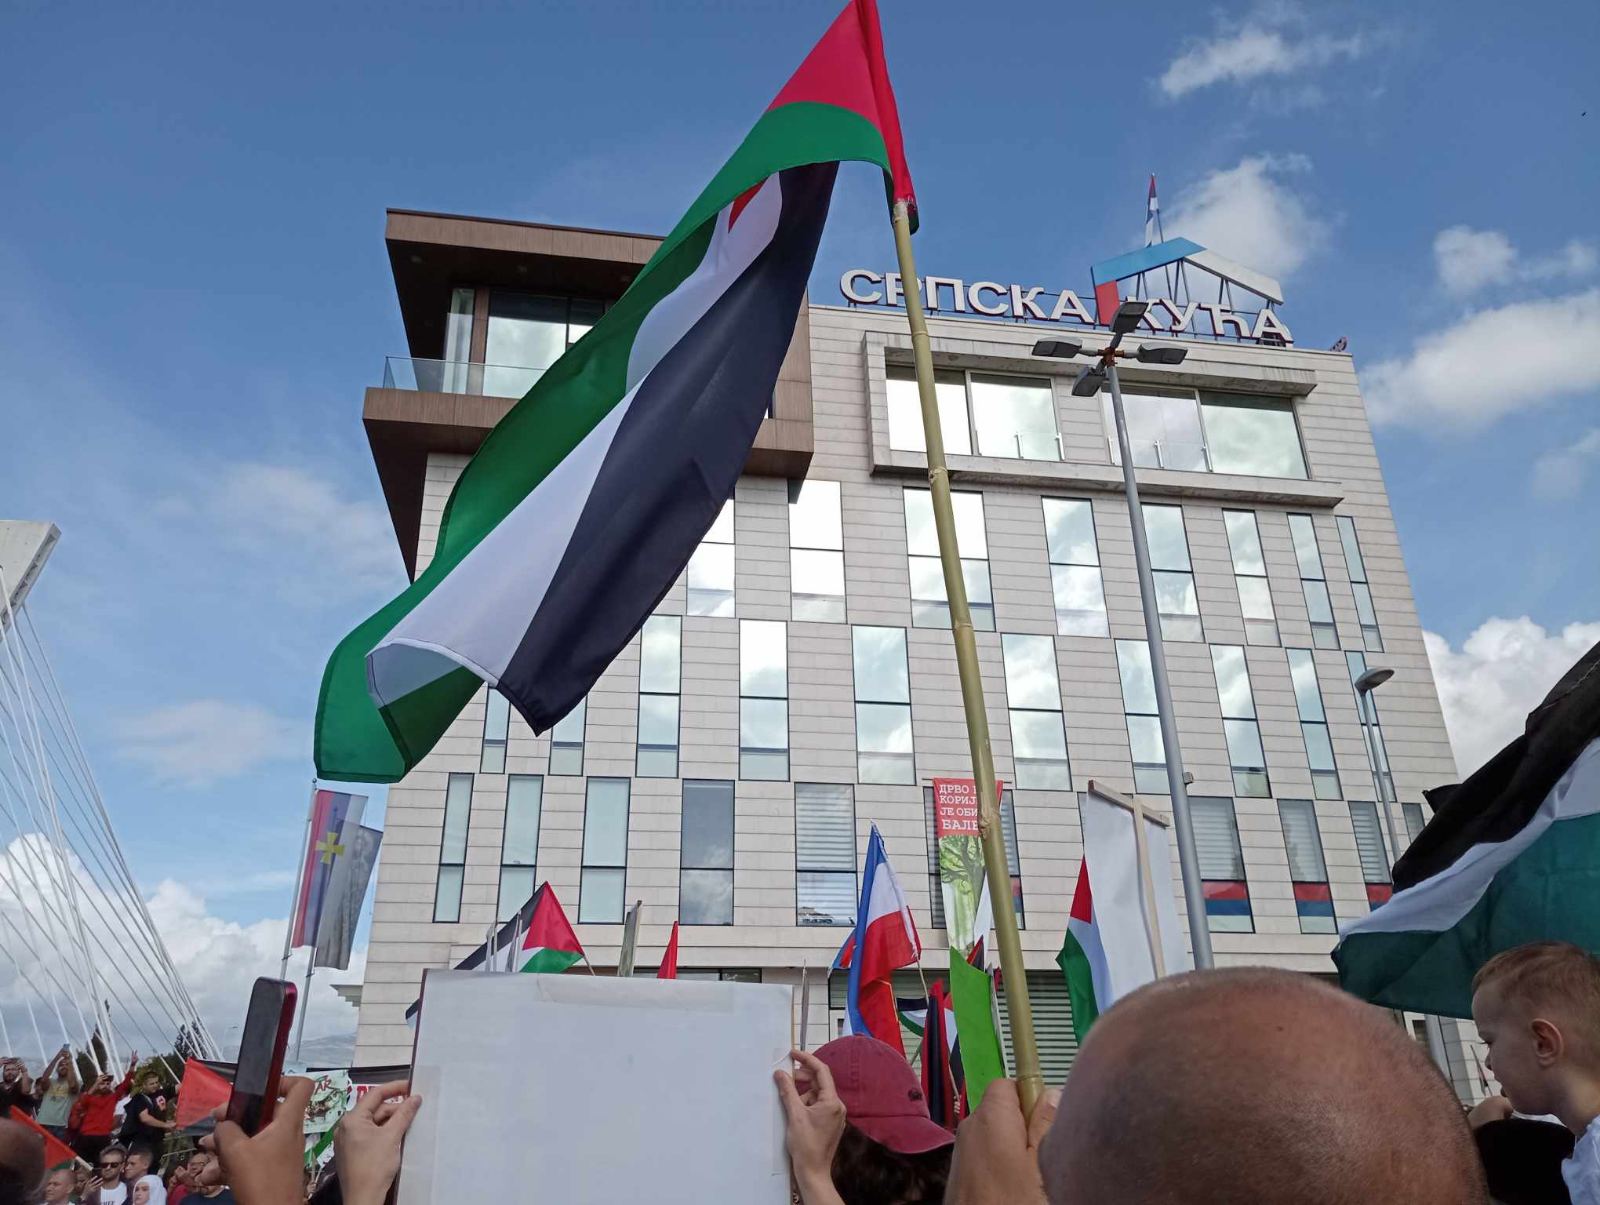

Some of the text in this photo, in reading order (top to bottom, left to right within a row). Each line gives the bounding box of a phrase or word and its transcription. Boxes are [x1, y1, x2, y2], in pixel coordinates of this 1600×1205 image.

[840, 268, 1095, 324] СРПСКА
[939, 784, 970, 795] ДРВО
[940, 795, 977, 805] КОРИЈ
[940, 807, 978, 817] ЈЕ ОБИ
